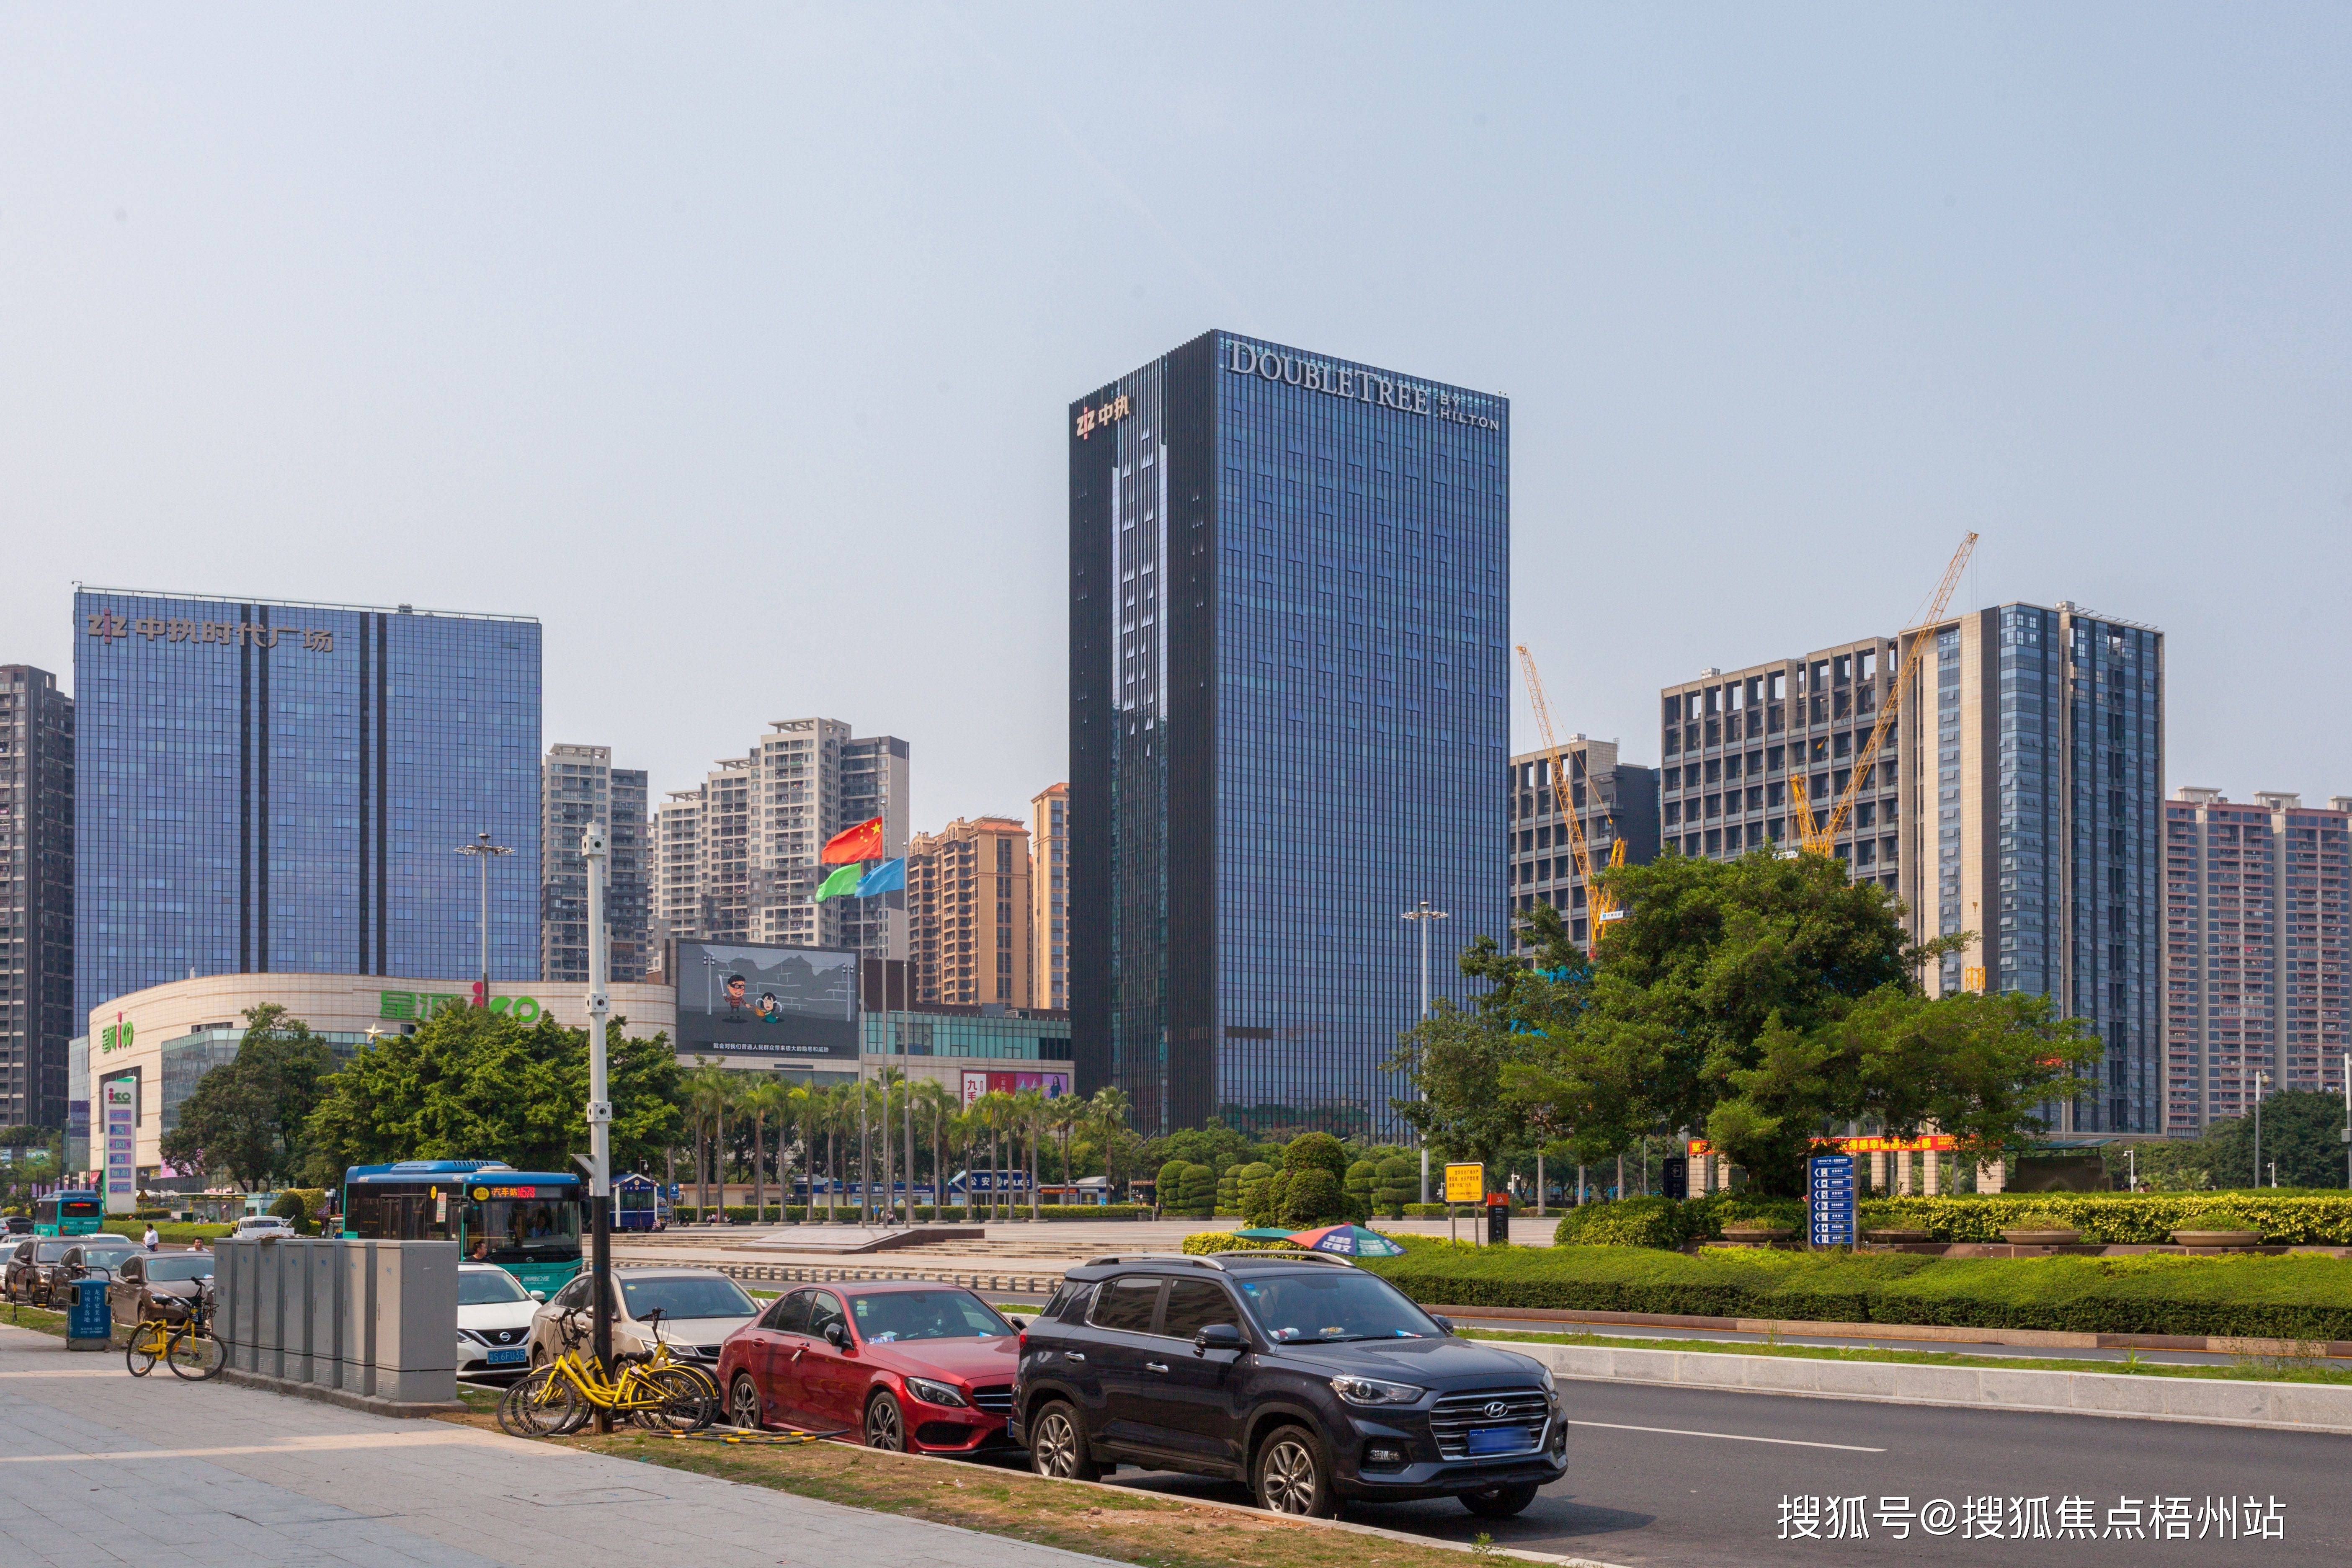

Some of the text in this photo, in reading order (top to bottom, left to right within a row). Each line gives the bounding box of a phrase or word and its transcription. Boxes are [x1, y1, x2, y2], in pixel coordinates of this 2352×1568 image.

[1230, 340, 1429, 415] DOUBLETREE
[1099, 395, 1129, 425] 中执
[1439, 394, 1461, 406] BY
[1439, 409, 1500, 431] HILTON
[135, 617, 334, 652] 中执时代广场
[971, 1176, 990, 1186] 公安
